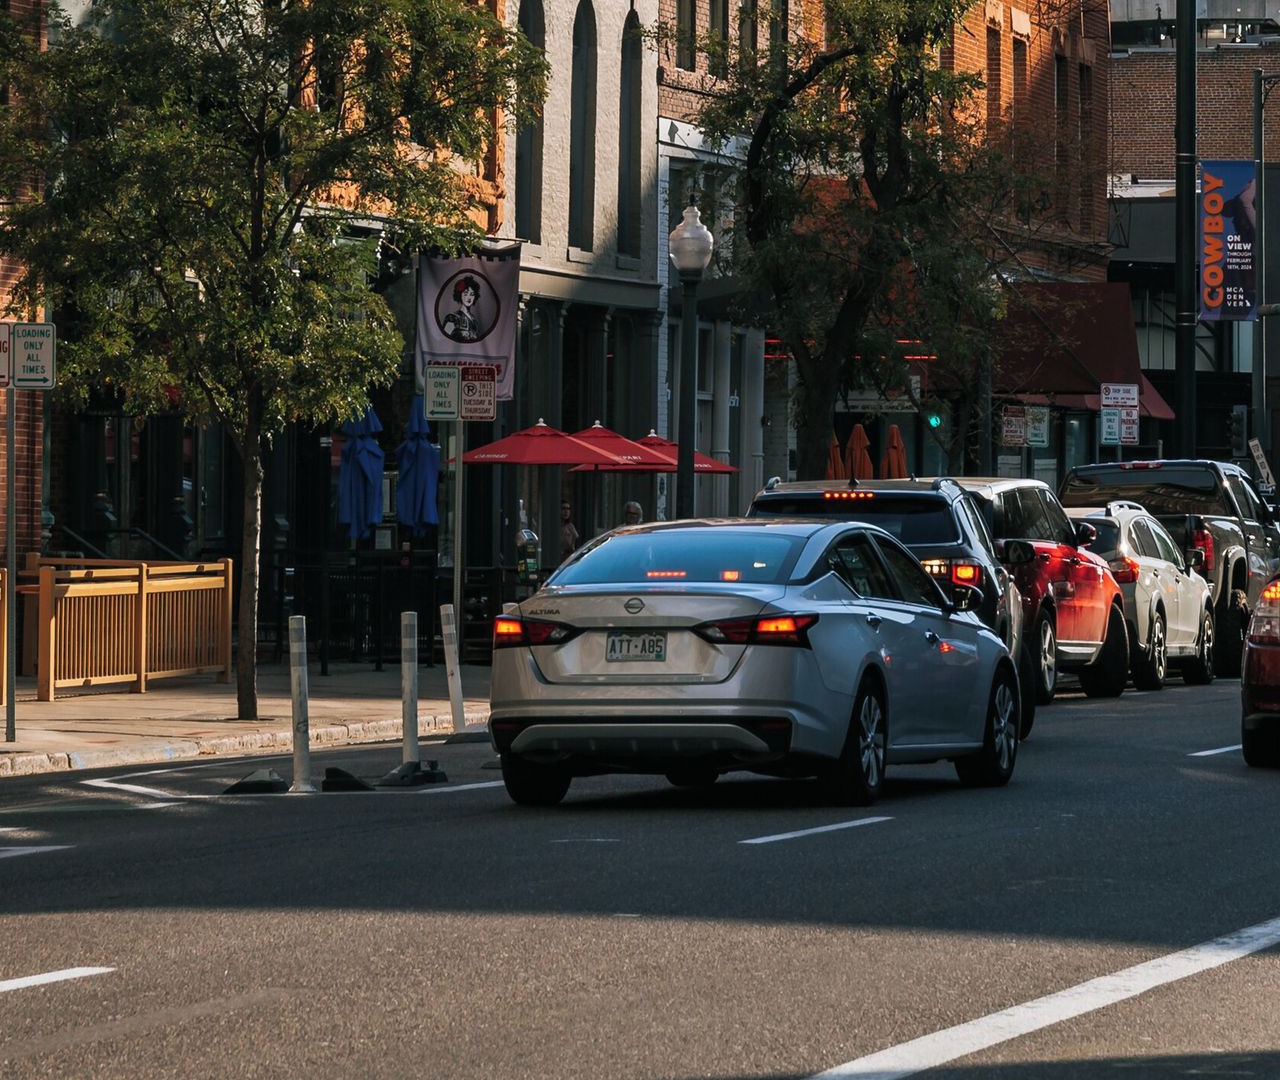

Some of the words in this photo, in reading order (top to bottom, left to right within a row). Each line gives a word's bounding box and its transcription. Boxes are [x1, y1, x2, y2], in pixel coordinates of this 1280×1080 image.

[1203, 172, 1224, 308] COWBOY
[1226, 234, 1240, 242] ON
[16, 329, 51, 338] LOADING
[23, 341, 43, 350] ONLY
[26, 354, 40, 362] ALL
[22, 365, 46, 374] TIMES
[429, 371, 457, 379] LOADING
[480, 382, 493, 390] THIS
[436, 390, 448, 398] ALL
[479, 390, 493, 398] SIDE
[432, 400, 452, 408] TIMES
